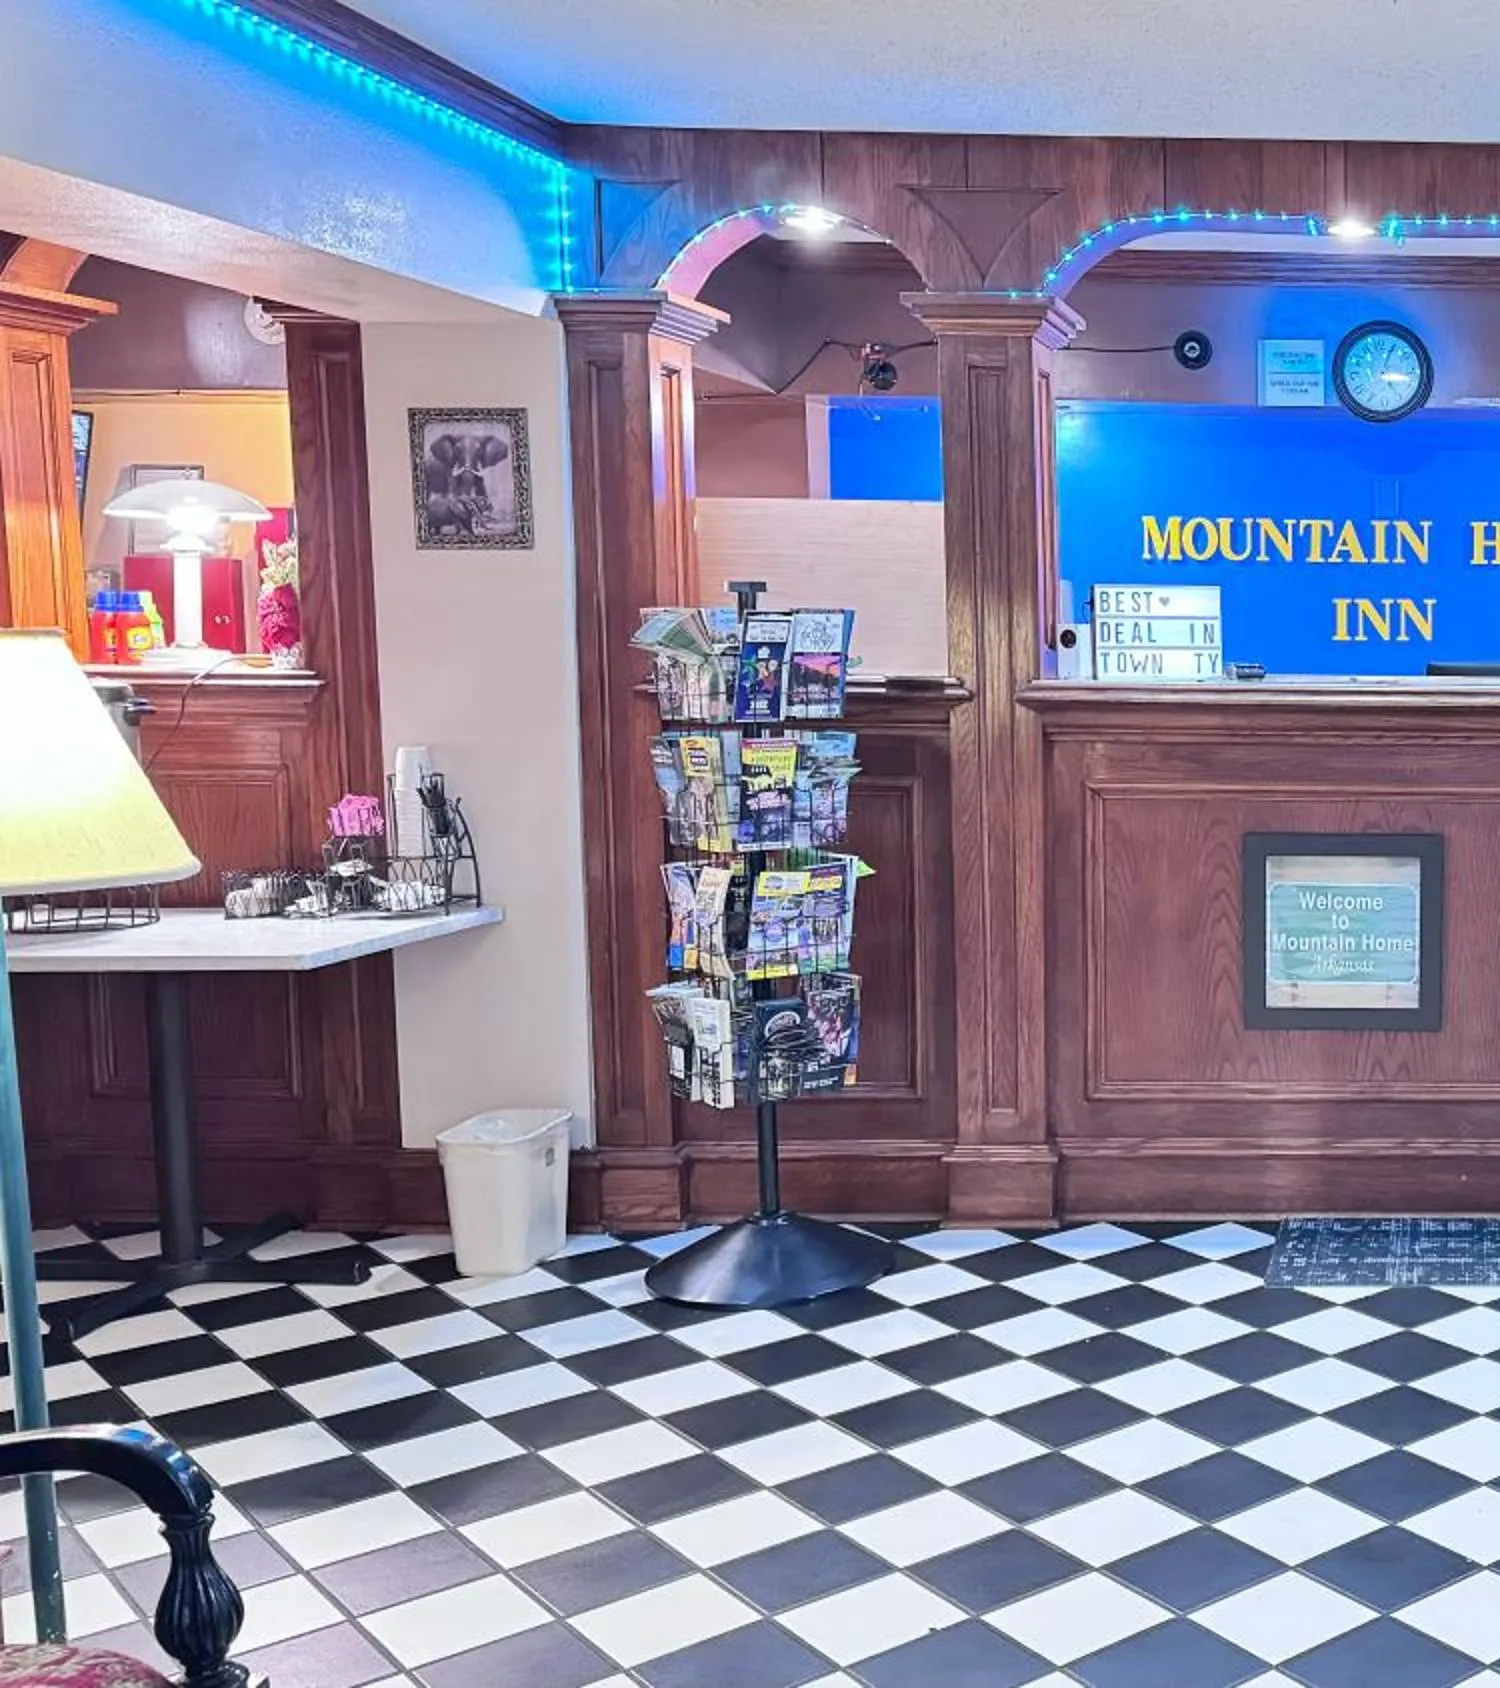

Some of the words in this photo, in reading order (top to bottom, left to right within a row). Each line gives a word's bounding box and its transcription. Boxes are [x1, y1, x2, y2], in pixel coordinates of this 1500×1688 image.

[1141, 514, 1433, 564] MOUNTAIN
[1099, 590, 1153, 613] BEST
[1331, 597, 1437, 642] INN
[1100, 621, 1157, 644] DEAL
[1188, 622, 1215, 645] IN
[1100, 651, 1163, 675] TOWN
[1193, 652, 1219, 675] TY
[1299, 891, 1384, 911] Welcome
[1331, 912, 1350, 930] to
[1272, 932, 1356, 952] Mountain
[1361, 932, 1414, 952] Home
